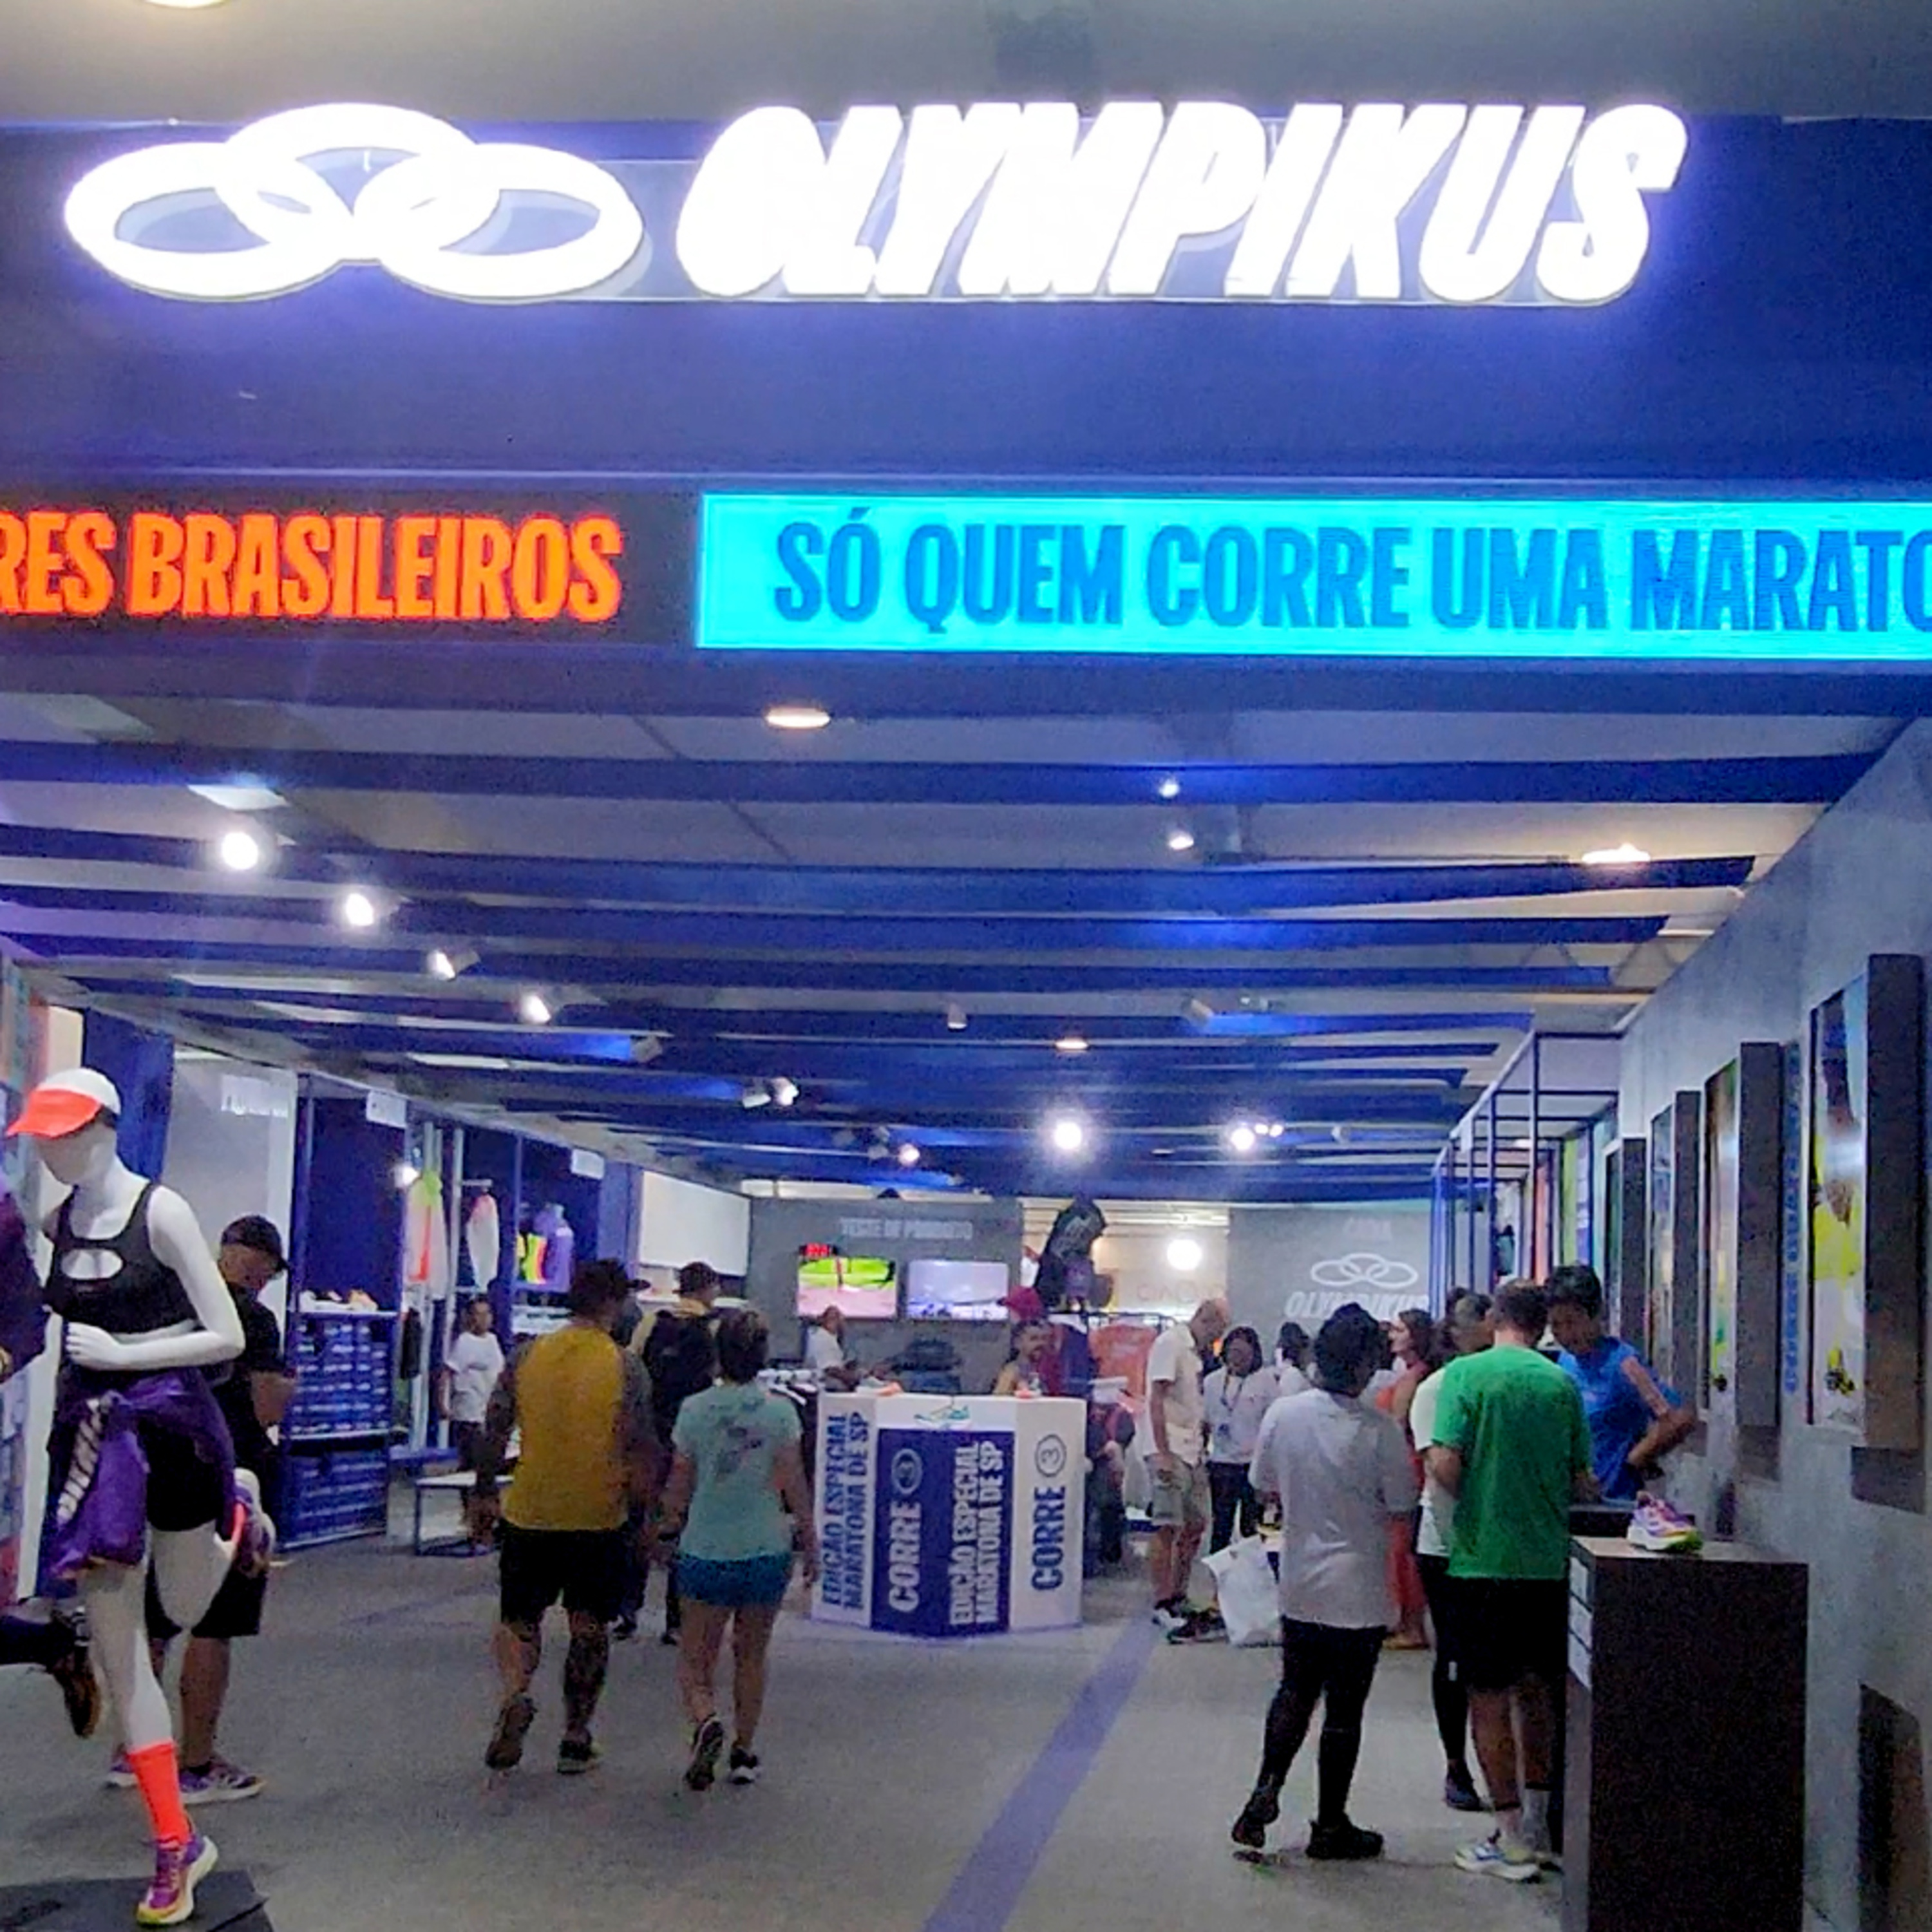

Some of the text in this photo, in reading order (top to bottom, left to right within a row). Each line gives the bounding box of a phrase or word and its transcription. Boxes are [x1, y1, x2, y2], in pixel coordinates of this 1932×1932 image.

[676, 101, 1687, 301] OLYMPIKUS
[128, 511, 623, 622] BRASILEIROS
[775, 507, 880, 623] SÓ
[904, 524, 1125, 634] QUEM
[1146, 524, 1411, 629] CORRE
[1432, 527, 1609, 630] UMA
[953, 1442, 979, 1541] ESPECIAL
[976, 1441, 1003, 1624] MARATONA DE SP
[1030, 1486, 1065, 1591] CORRE
[888, 1501, 922, 1612] CORRE
